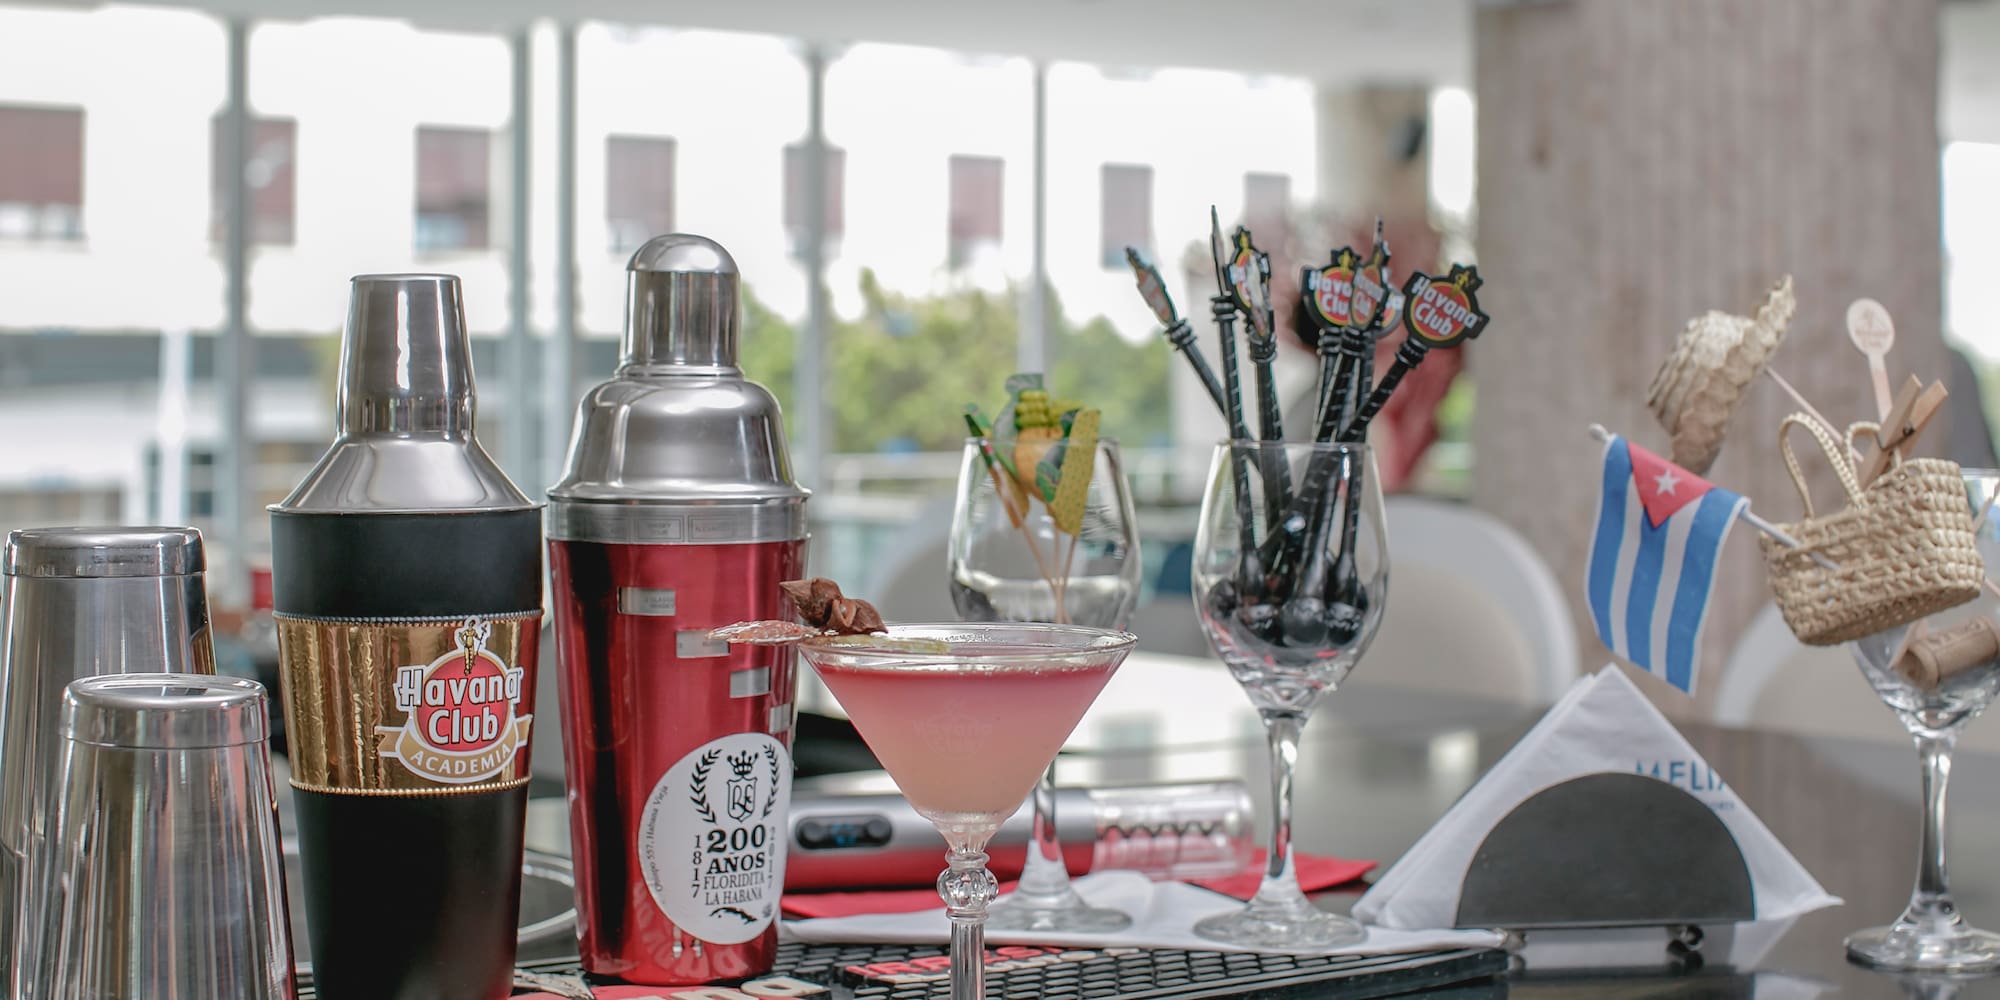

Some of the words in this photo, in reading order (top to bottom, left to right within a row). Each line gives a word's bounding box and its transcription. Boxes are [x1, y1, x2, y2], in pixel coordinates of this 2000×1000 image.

[1309, 270, 1353, 298] Hava
[1322, 293, 1350, 316] Clu
[1411, 276, 1478, 329] Havana
[1415, 303, 1453, 336] Club
[400, 668, 519, 707] Havana
[428, 706, 499, 745] Club
[411, 743, 511, 775] ACADEMIA
[707, 824, 766, 853] 200
[706, 851, 765, 875] AÑOS
[704, 871, 765, 890] FLORIDITA
[705, 892, 720, 906] LA
[723, 887, 762, 904] HABANA
